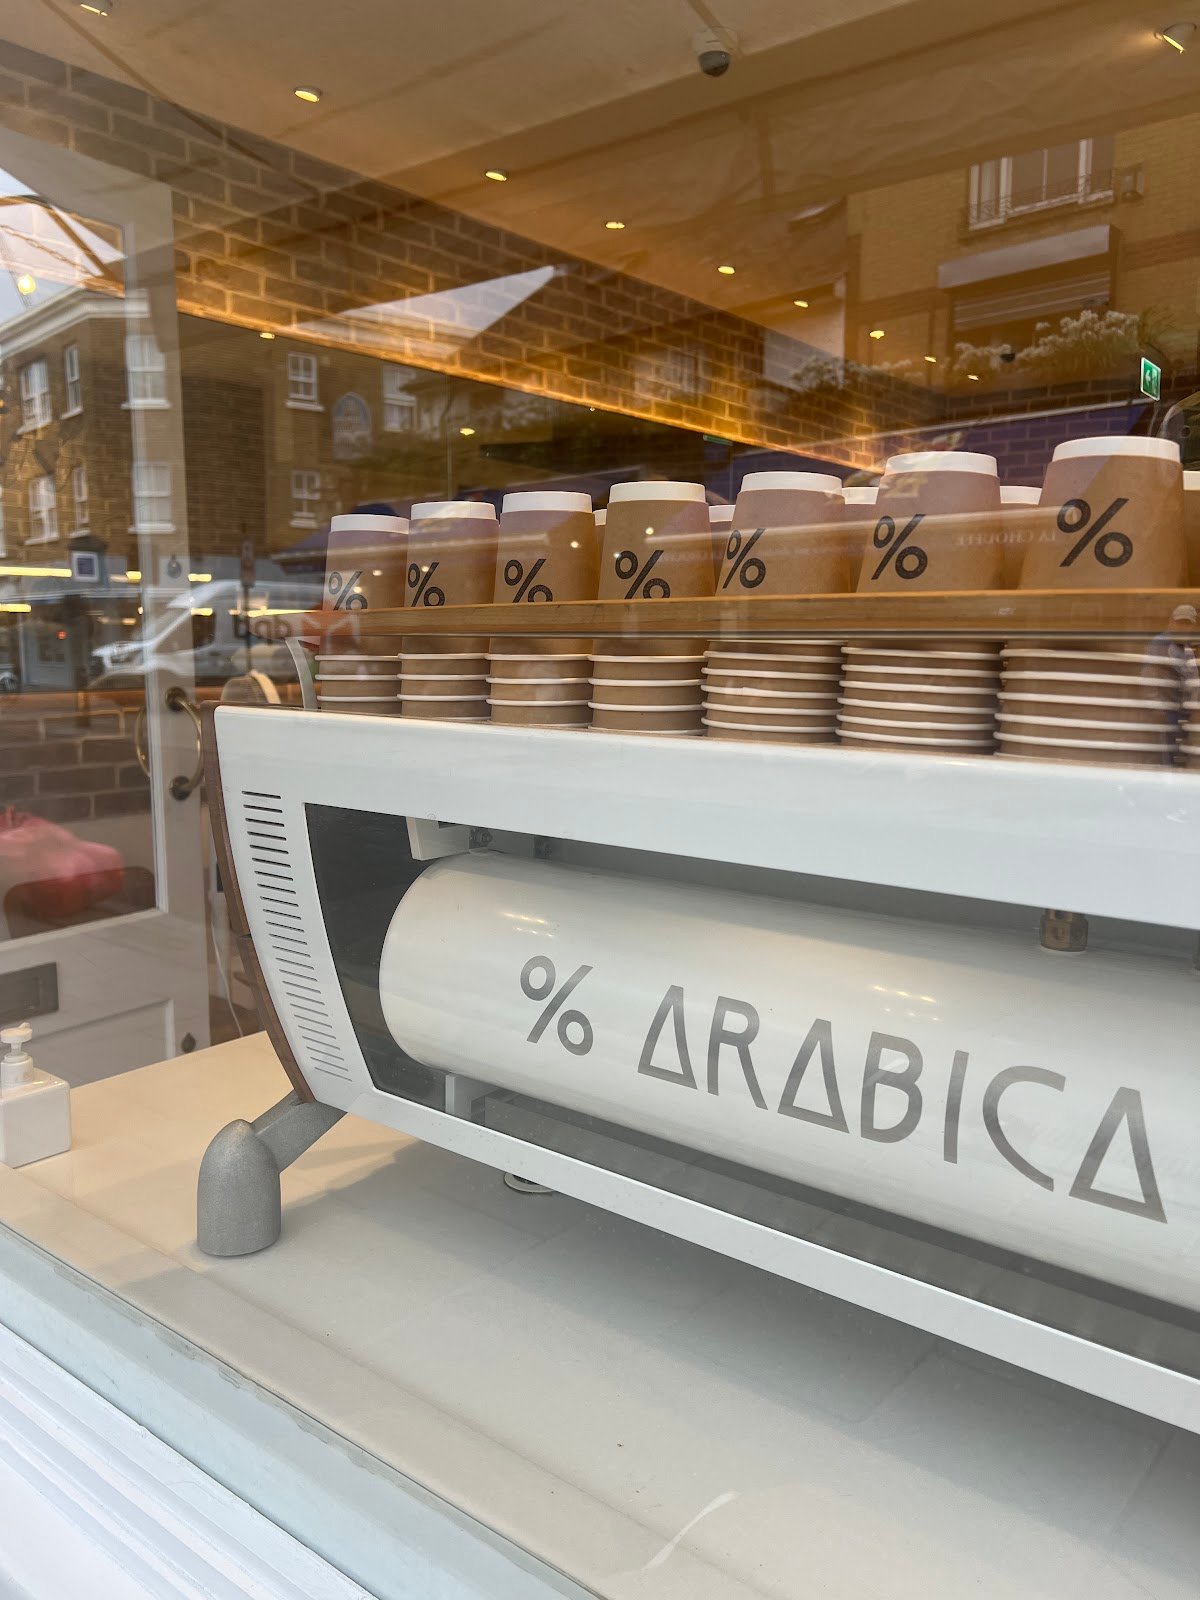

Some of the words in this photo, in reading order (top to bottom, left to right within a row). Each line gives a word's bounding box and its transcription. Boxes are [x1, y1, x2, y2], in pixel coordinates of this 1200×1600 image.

[722, 528, 767, 589] %
[871, 513, 928, 580] %
[1056, 498, 1134, 568] %
[408, 562, 446, 607] %
[504, 559, 554, 603] %
[615, 550, 671, 599] %
[520, 955, 594, 1056] %
[637, 985, 1168, 1224] ARABICA
